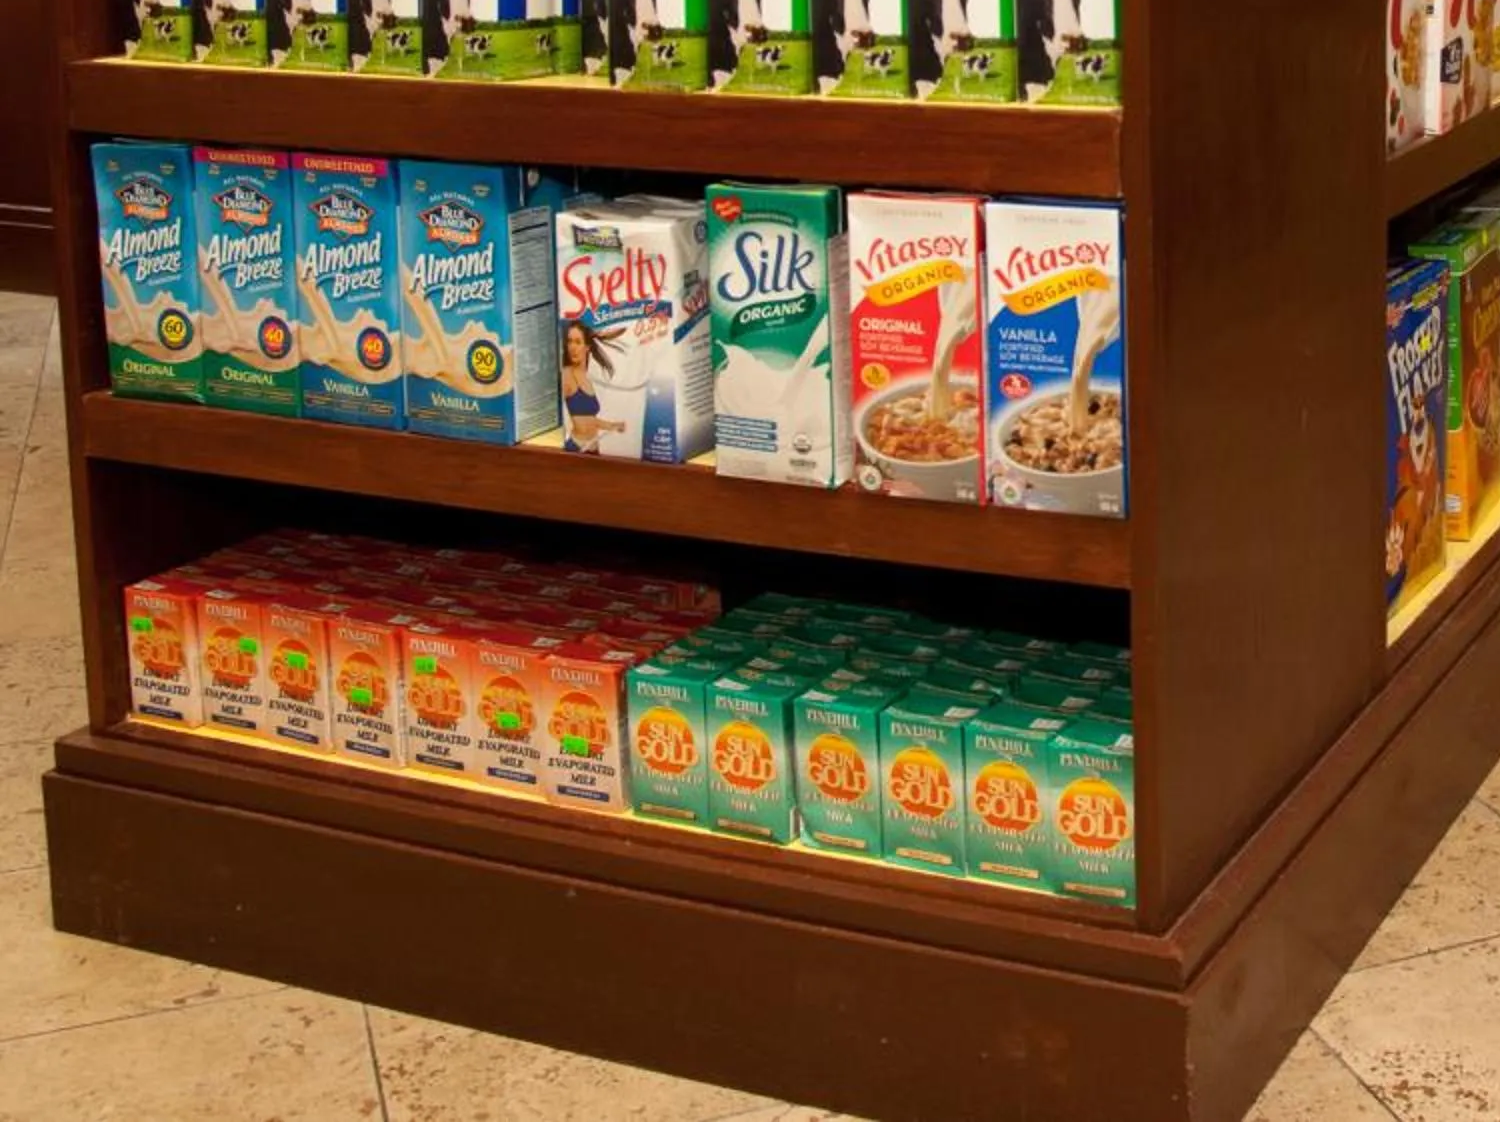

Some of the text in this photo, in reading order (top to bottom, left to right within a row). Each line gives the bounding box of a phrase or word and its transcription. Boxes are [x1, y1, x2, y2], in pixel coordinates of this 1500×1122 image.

[106, 216, 181, 266] Almond
[204, 224, 282, 273] Almond
[135, 250, 182, 282] Breeze
[303, 231, 382, 283] Almond
[411, 242, 494, 295] Almond
[717, 231, 816, 302] Silk
[235, 257, 283, 289] Breeze
[333, 267, 382, 298] Breeze
[562, 247, 668, 319] Svelty
[881, 264, 954, 300] ORGANIC
[441, 277, 494, 310] Breeze
[1022, 272, 1096, 308] ORGANIC
[739, 298, 806, 324] ORGANIC
[859, 317, 925, 335] ORIGINAL
[164, 320, 183, 335] 60
[999, 328, 1057, 344] VANILLA
[123, 358, 176, 377] ORIGINAL
[475, 352, 493, 365] 90
[221, 366, 275, 386] ORIGINAL
[323, 379, 369, 396] VANILLA
[431, 392, 480, 411] VANILLA
[650, 722, 684, 741] SUN
[727, 735, 763, 755] SUN
[636, 736, 699, 767] GOLD
[713, 750, 777, 782] GOLD
[819, 749, 855, 769] SUN
[808, 762, 870, 794] GOLD
[903, 764, 940, 784] SUN
[987, 777, 1027, 798] SUN
[889, 778, 954, 809] GOLD
[974, 792, 1041, 823] GOLD
[1073, 795, 1115, 815] SUN
[1057, 809, 1131, 839] GOLD
